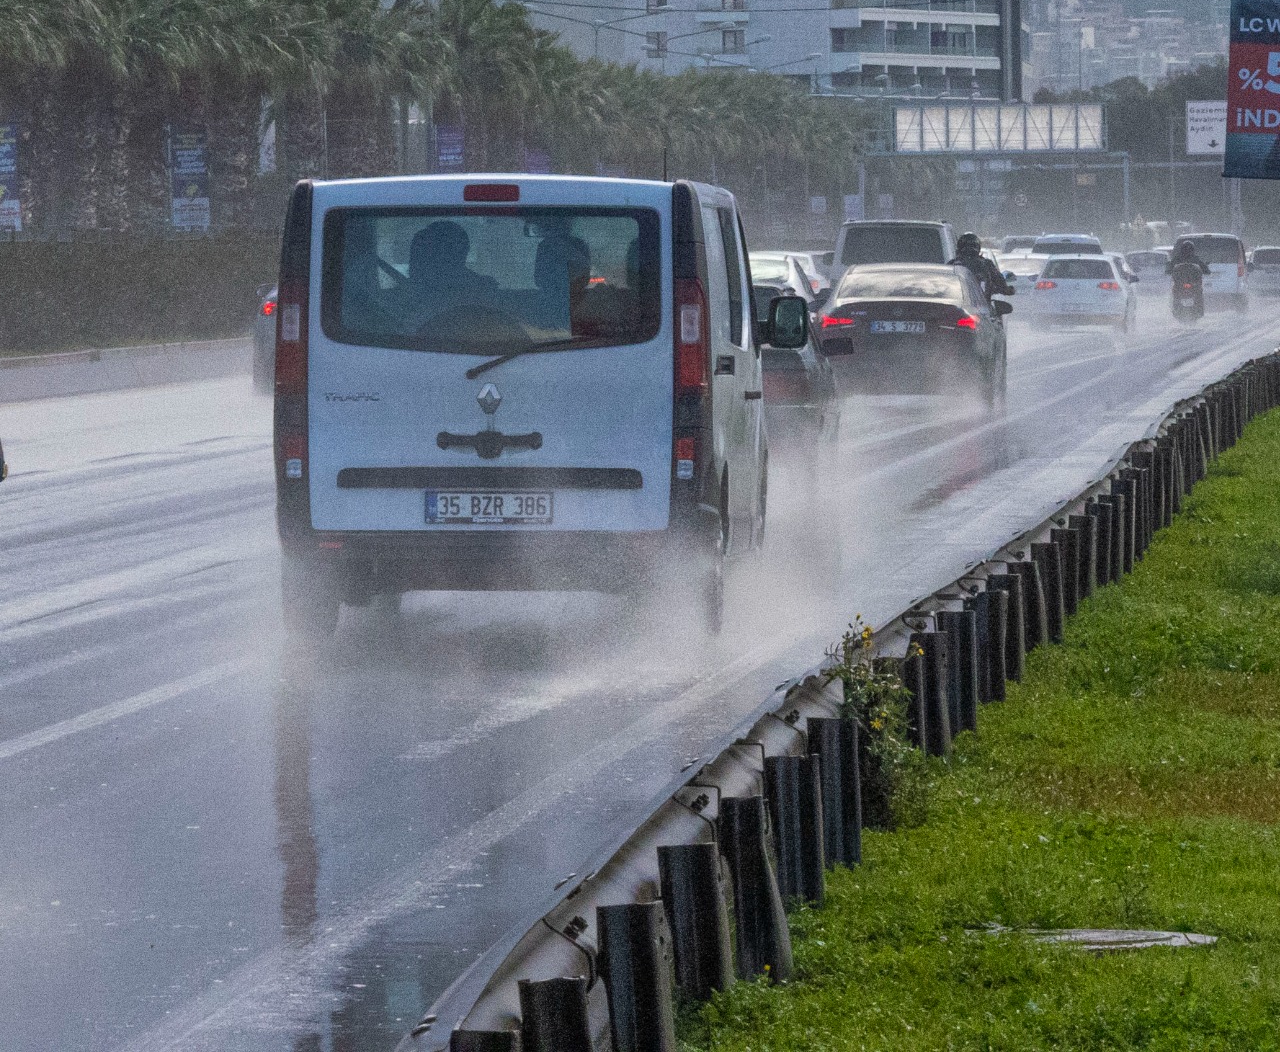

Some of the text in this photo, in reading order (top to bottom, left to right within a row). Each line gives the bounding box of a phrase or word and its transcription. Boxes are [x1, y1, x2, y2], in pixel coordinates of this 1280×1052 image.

[1239, 17, 1263, 32] LC
[439, 496, 547, 516] 35 BZR 386
